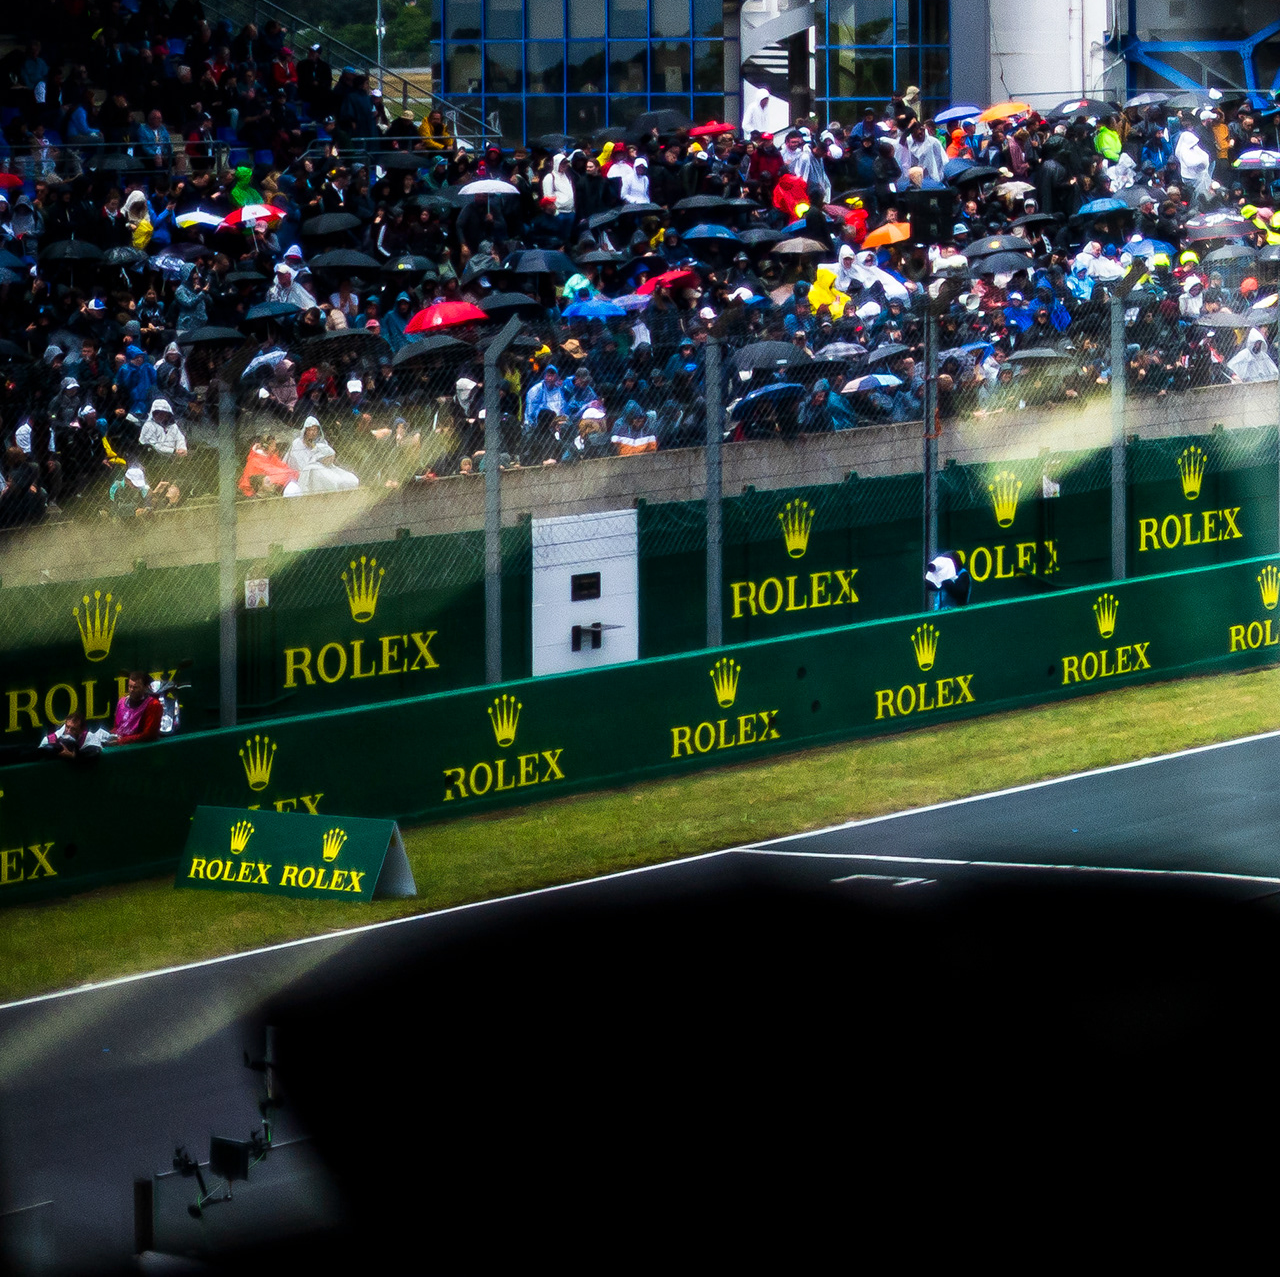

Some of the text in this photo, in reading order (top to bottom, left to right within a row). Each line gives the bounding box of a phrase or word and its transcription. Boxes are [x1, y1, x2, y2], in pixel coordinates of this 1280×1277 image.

[1139, 507, 1243, 552] ROLEX
[731, 568, 859, 619] ROLEX
[283, 630, 440, 689] ROLEX
[1062, 641, 1151, 686] ROLEX
[875, 673, 976, 720] ROLEX
[670, 709, 781, 759] ROLEX
[443, 748, 566, 802] ROLEX
[187, 858, 366, 893] ROLEX ROLEX
